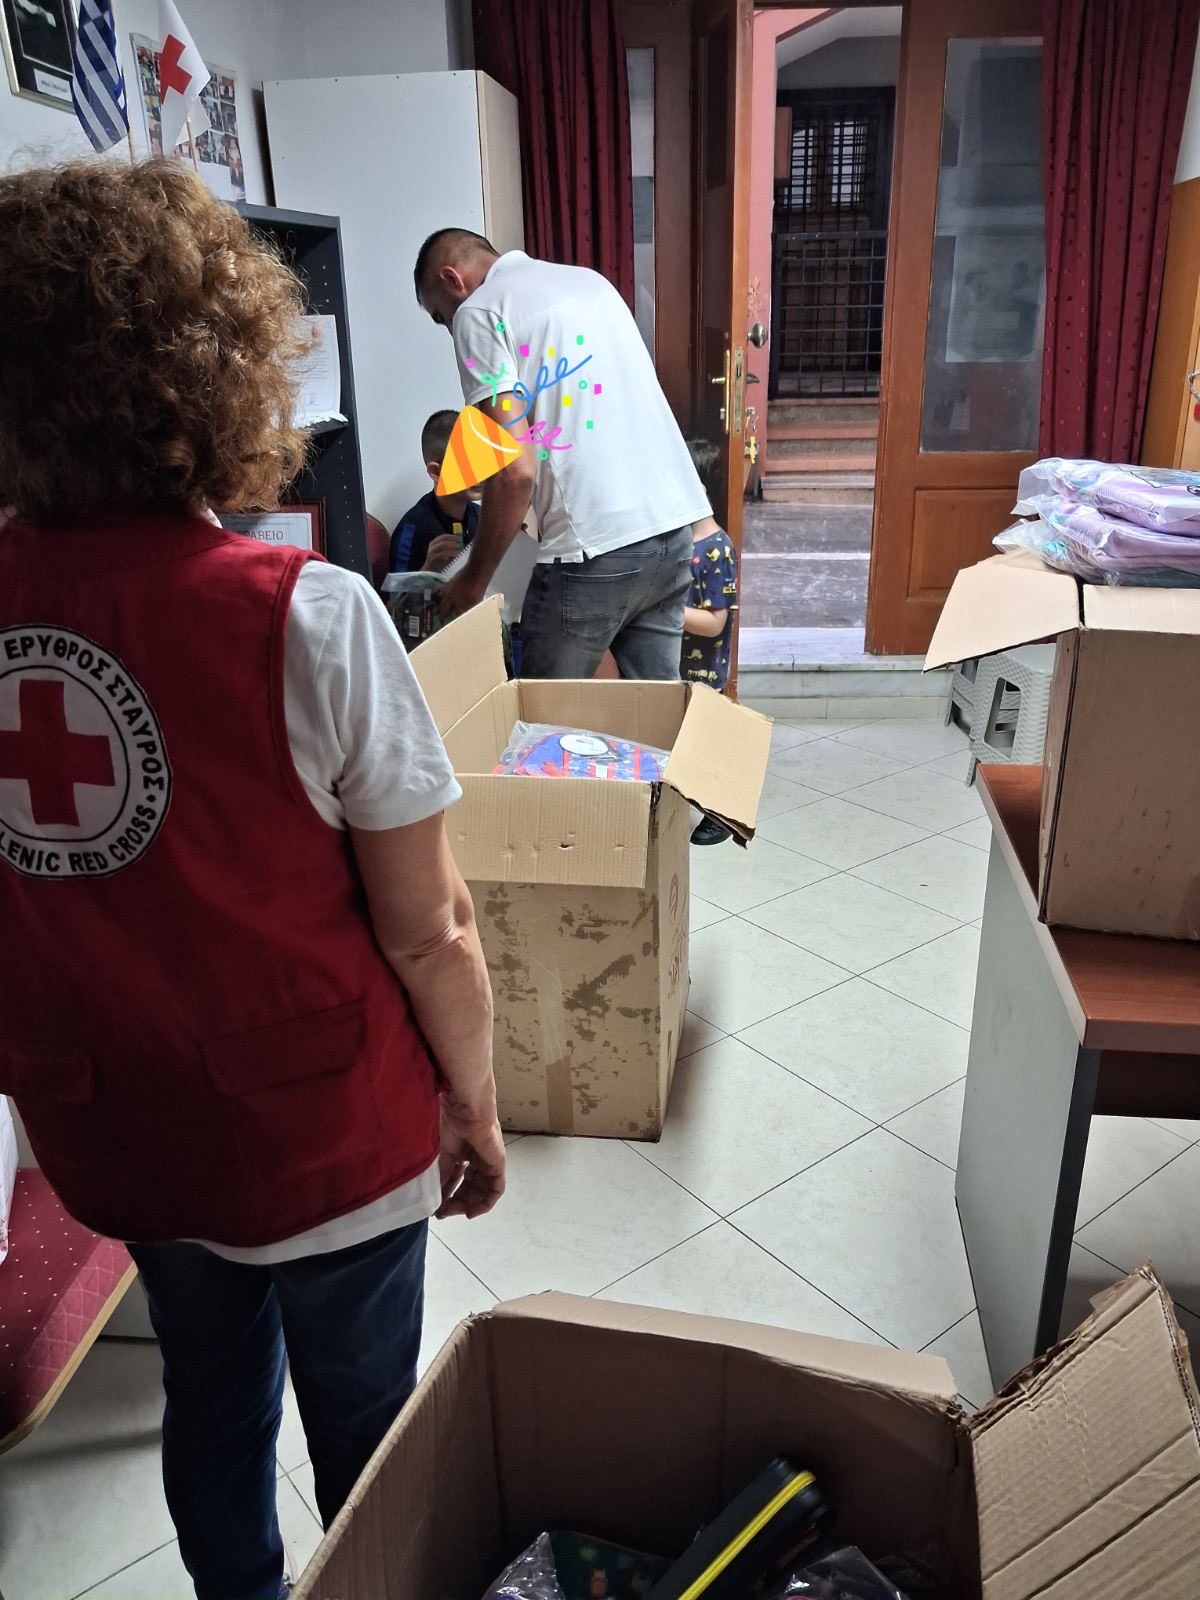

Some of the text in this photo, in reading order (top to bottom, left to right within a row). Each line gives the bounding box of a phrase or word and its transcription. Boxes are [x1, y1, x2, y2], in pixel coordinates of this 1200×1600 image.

[4, 634, 164, 790] ΕΡΥΘΡΟΣ ΣΤΑΥΡΟΣ
[69, 852, 108, 872] RED
[108, 804, 157, 862] CROSS
